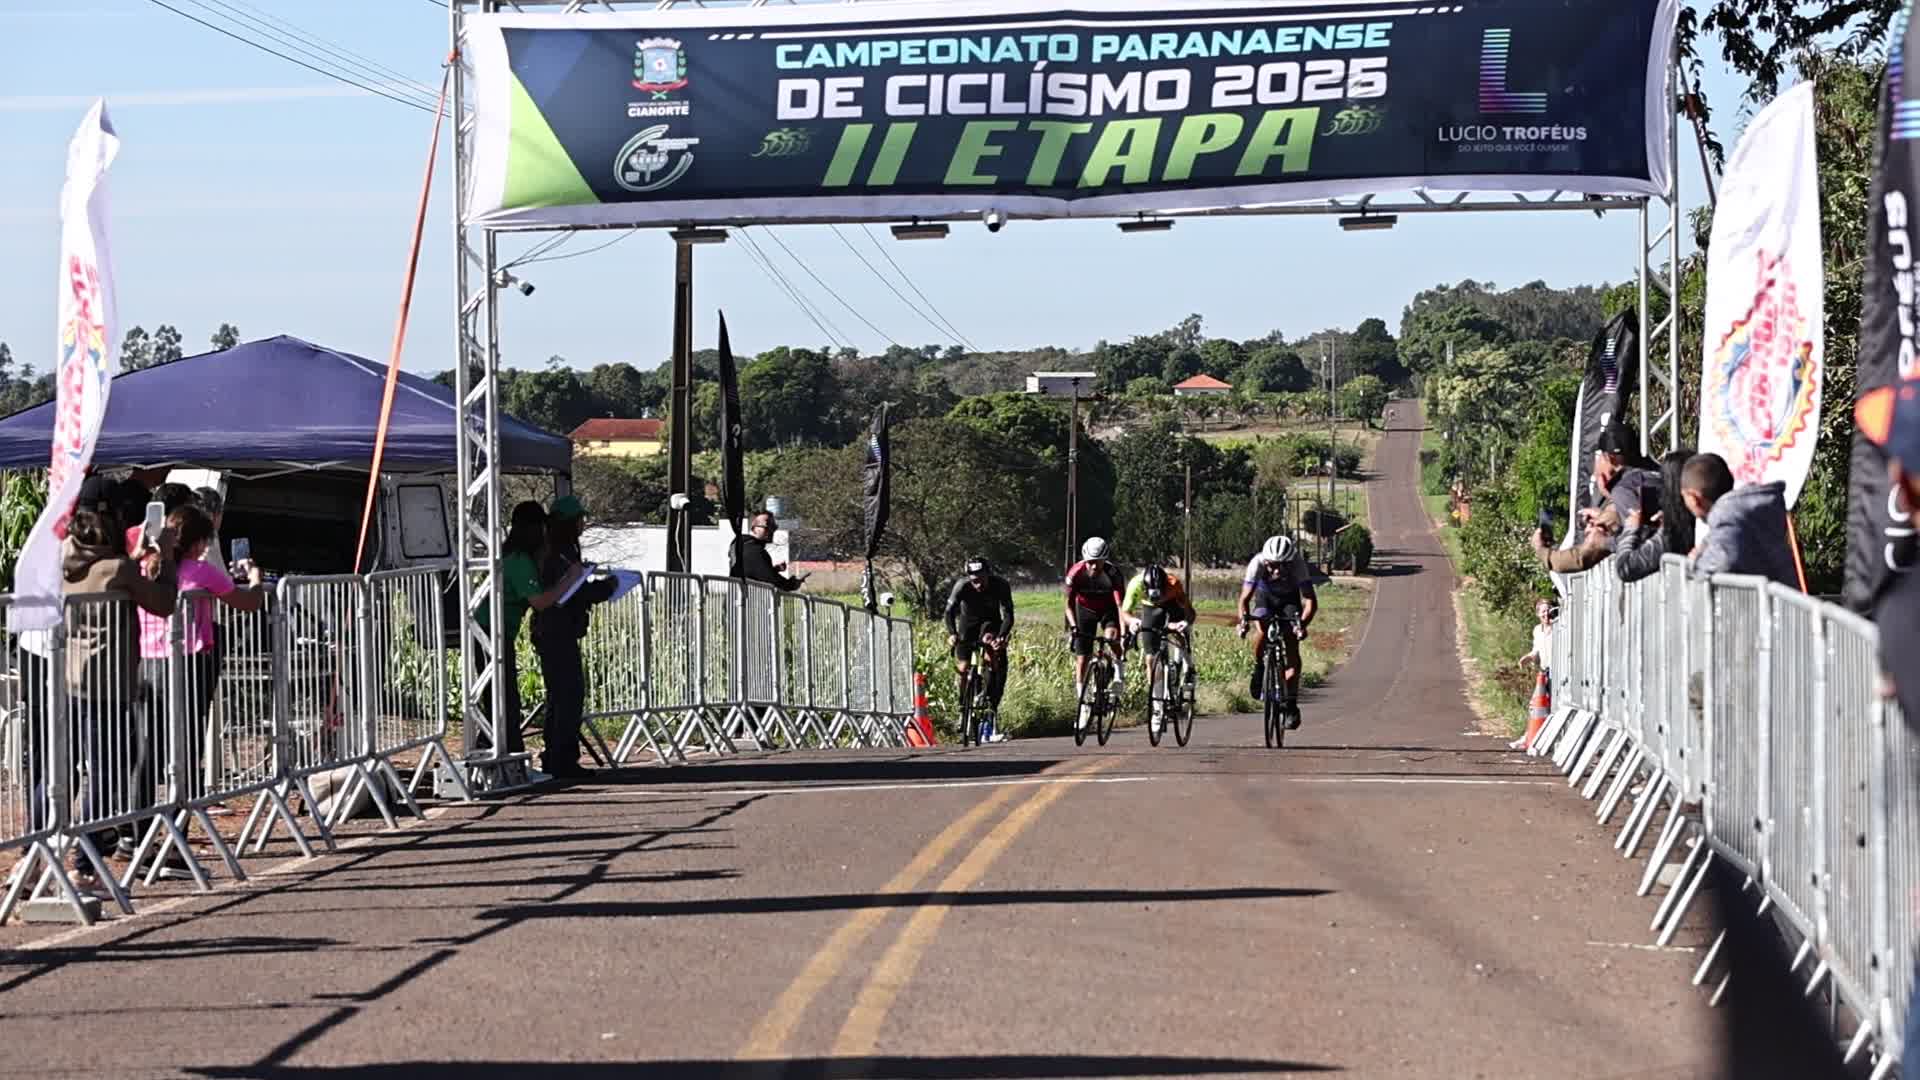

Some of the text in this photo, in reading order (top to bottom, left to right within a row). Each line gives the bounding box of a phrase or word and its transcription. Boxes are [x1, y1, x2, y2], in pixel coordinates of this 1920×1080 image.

[776, 22, 1393, 69] CAMPEONATO PARANAENSE
[628, 105, 689, 117] CIANORTE
[777, 76, 864, 120] DE
[885, 60, 1192, 117] CICLÍSMO
[821, 106, 1321, 189] II ETAPA
[1438, 123, 1588, 141] LUCIO TROFÉUS
